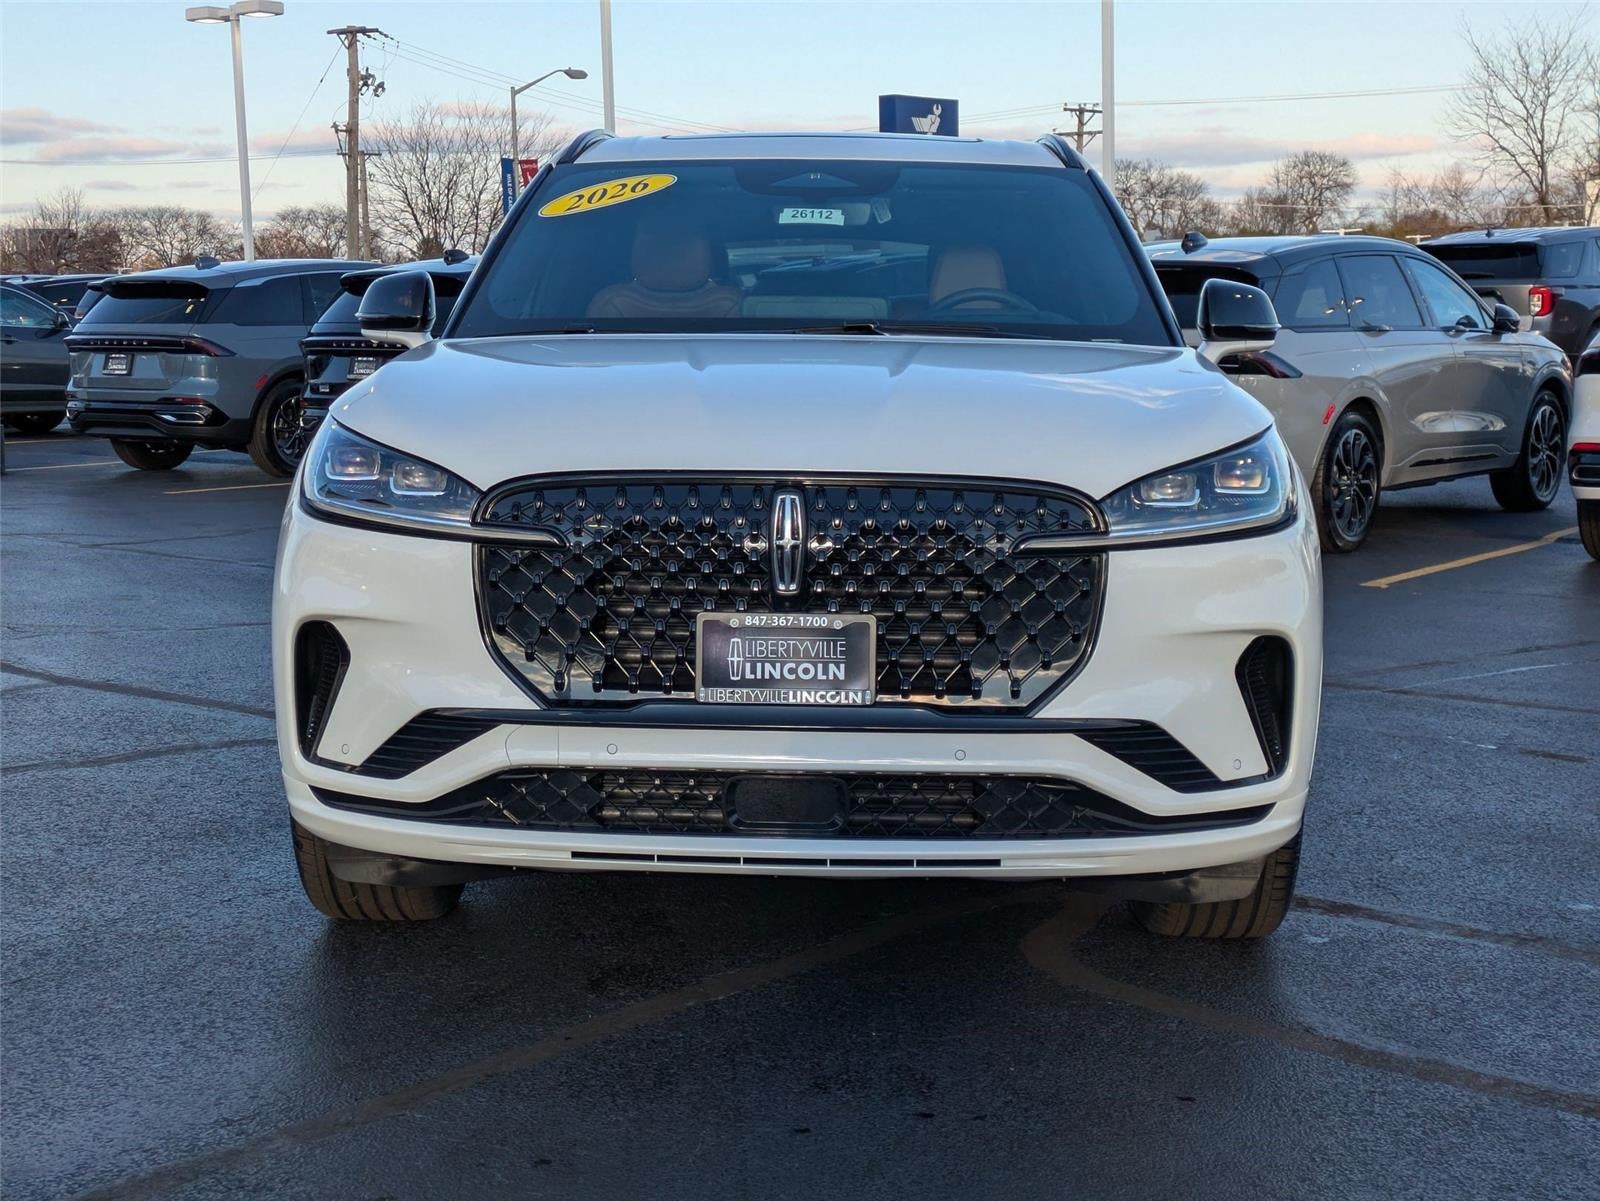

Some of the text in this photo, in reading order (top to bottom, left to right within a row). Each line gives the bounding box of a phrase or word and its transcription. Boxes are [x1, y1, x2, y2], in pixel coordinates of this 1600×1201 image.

[565, 177, 650, 211] 2026
[791, 209, 833, 219] 26112
[744, 616, 828, 627] 847-367-1700
[745, 639, 846, 659] LIBERTYVILLE
[745, 662, 846, 681] LINCOLN
